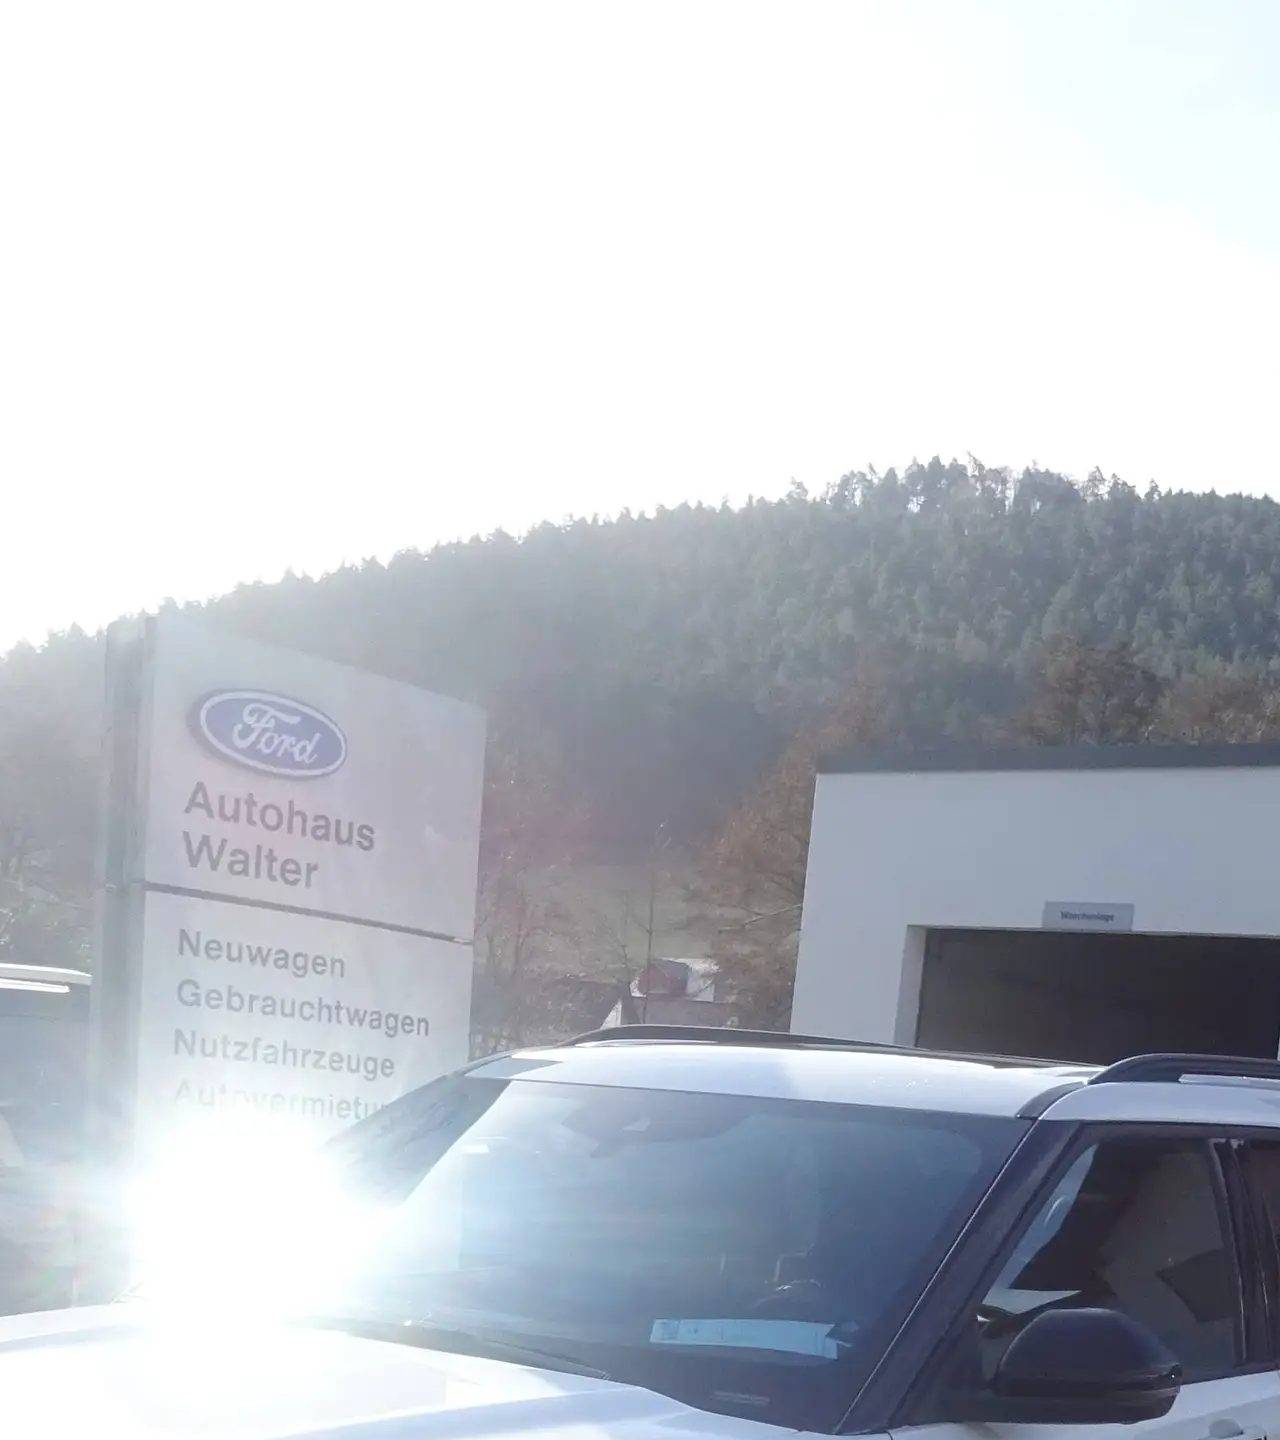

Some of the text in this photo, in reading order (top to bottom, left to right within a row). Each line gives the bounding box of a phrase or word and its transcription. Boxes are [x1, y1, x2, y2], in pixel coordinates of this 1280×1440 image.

[231, 702, 322, 764] Ford
[184, 780, 376, 851] Autohaus
[182, 830, 319, 889] Walter
[177, 928, 346, 979] Neuwagen
[176, 978, 430, 1038] Gebrauchtwagen
[172, 1027, 396, 1082] Nutzfahrzeuge
